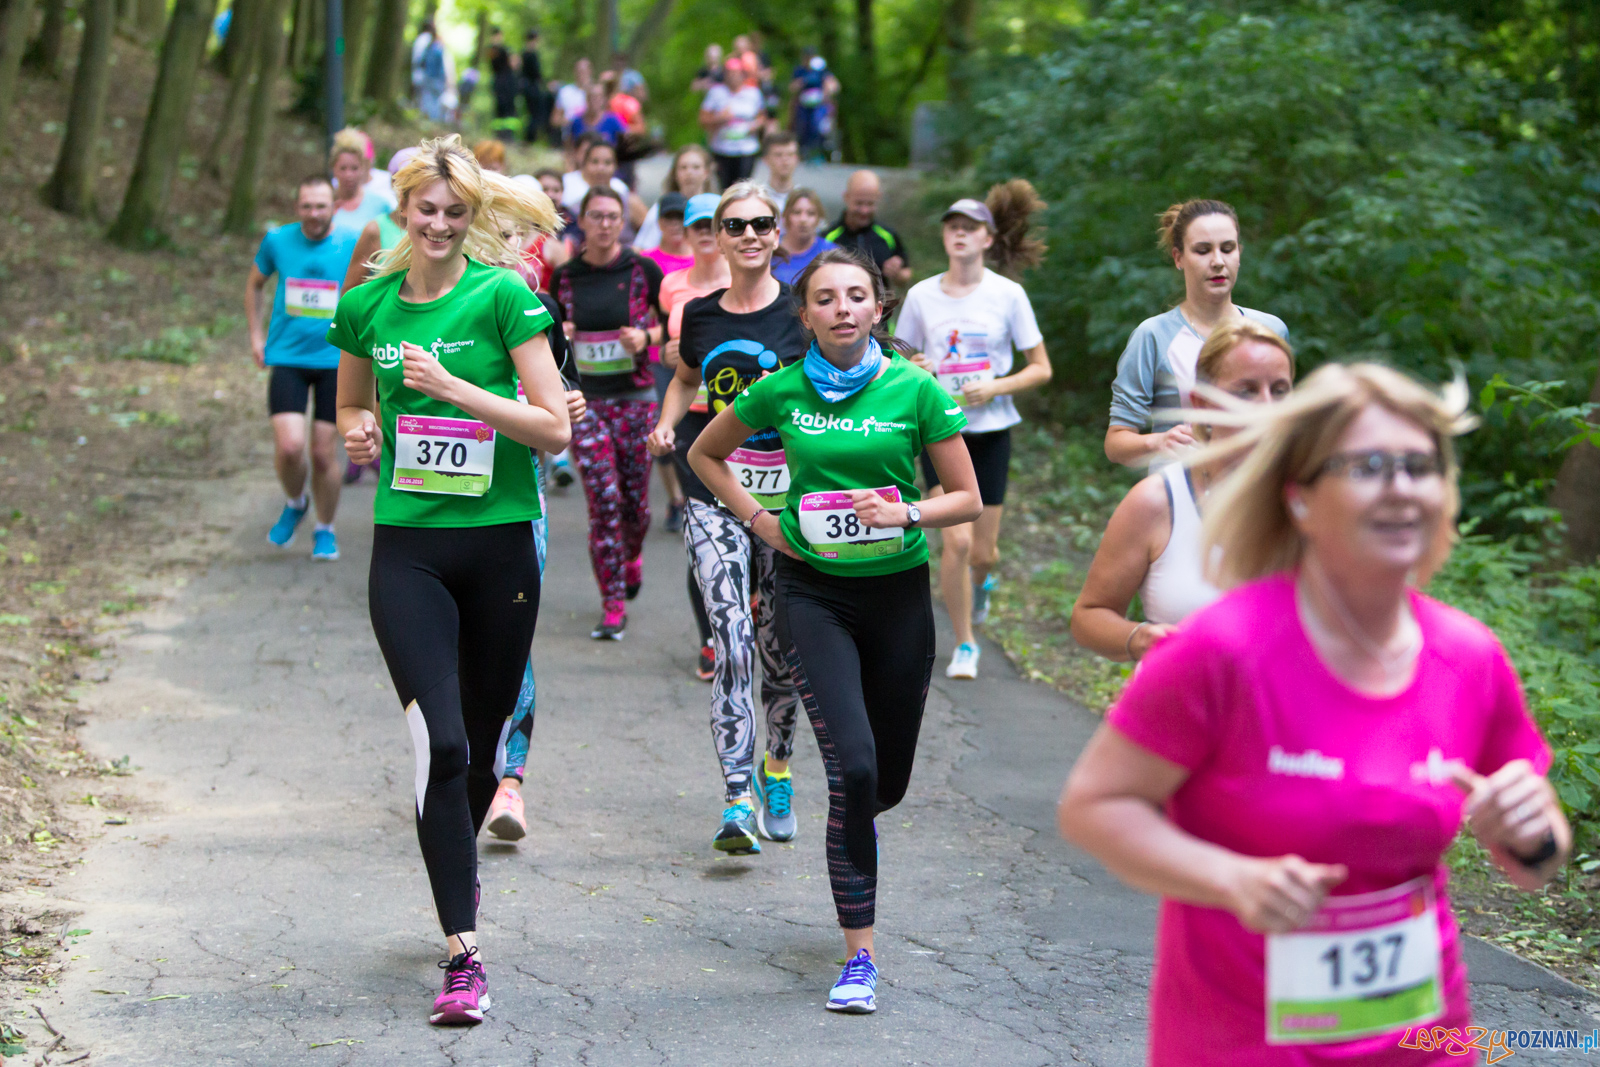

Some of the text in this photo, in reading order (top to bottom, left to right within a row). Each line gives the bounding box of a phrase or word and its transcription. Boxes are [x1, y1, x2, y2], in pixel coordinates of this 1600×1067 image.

[443, 340, 474, 350] sportowy
[586, 343, 616, 359] 317
[791, 408, 854, 435] żabka
[874, 421, 907, 430] sportowy
[416, 439, 467, 468] 370
[740, 467, 783, 490] 377
[1321, 932, 1405, 990] 137
